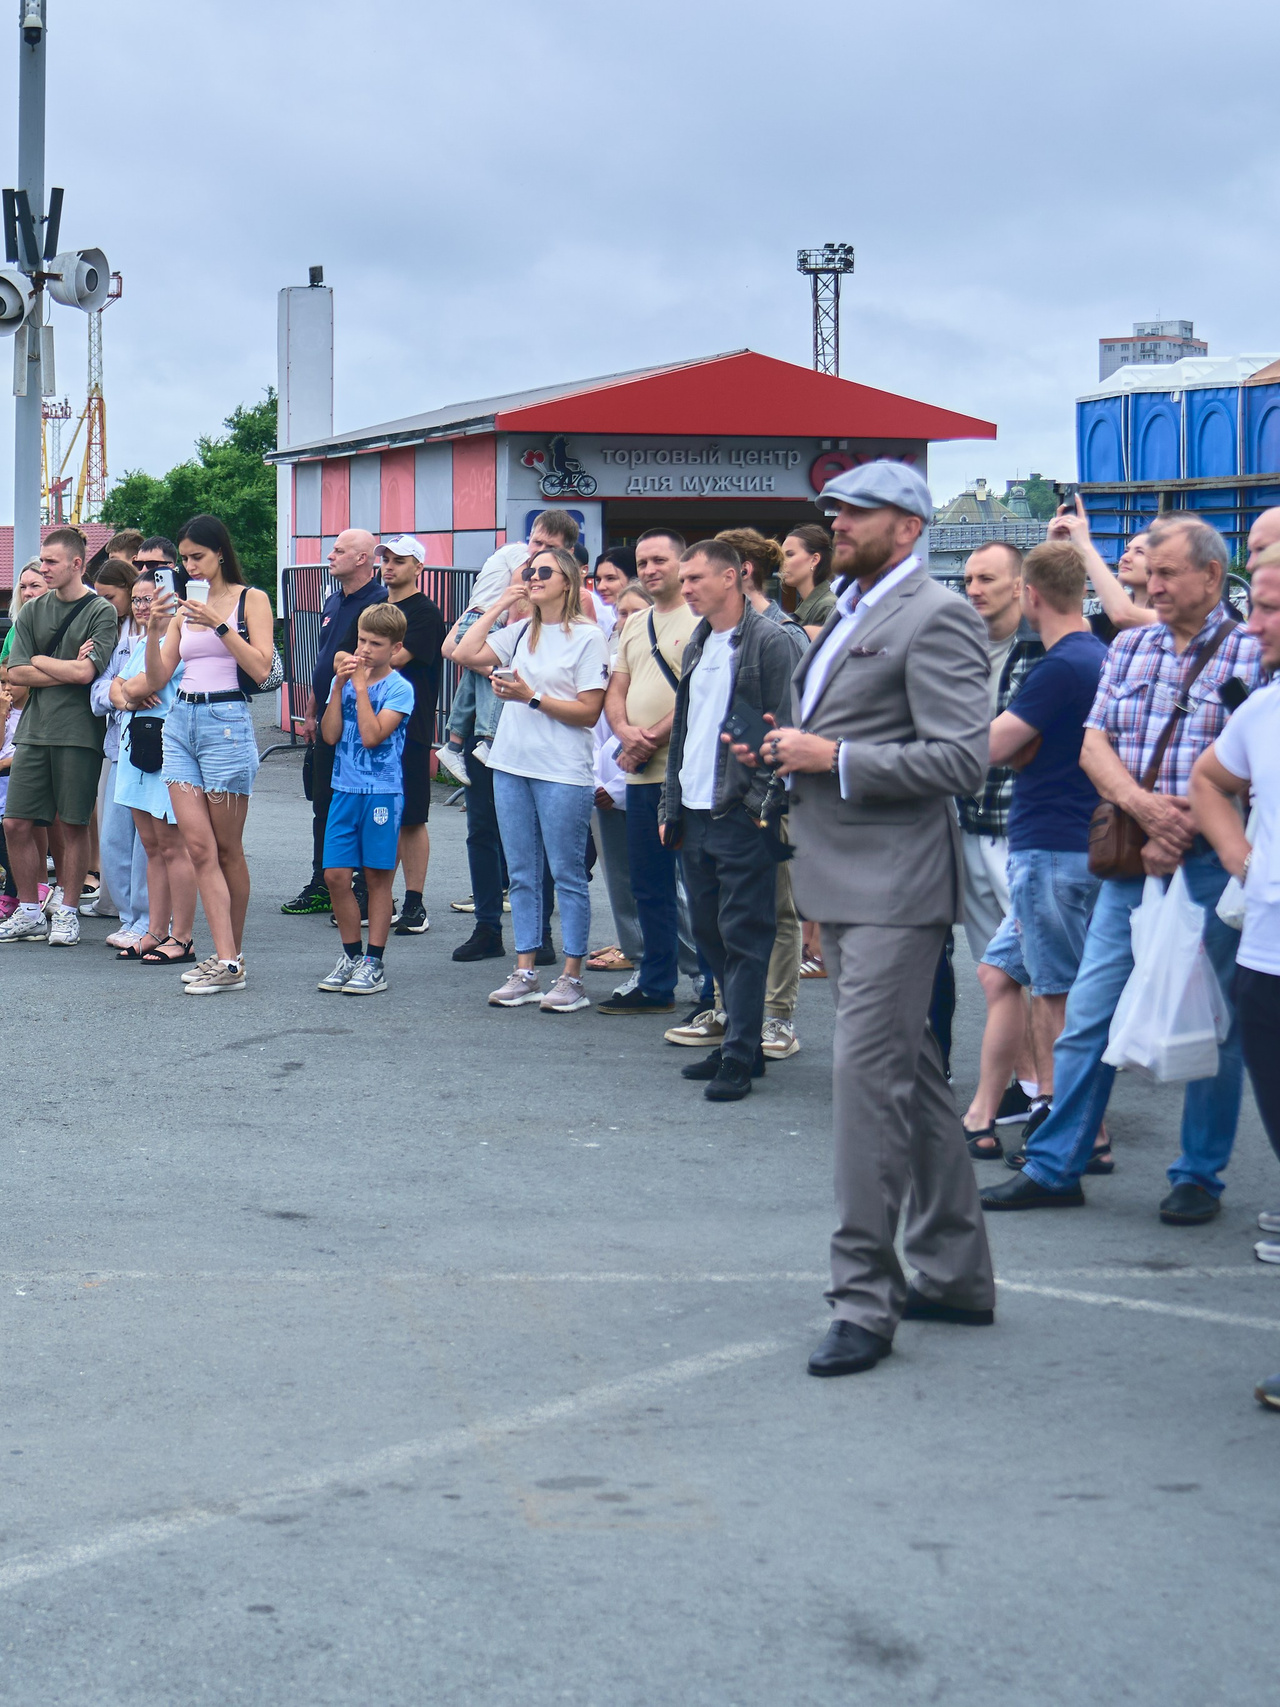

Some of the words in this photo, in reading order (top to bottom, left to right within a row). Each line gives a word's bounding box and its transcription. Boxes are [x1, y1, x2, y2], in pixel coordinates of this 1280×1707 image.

[602, 442, 724, 469] торговый
[729, 447, 802, 470] центр
[810, 440, 918, 495] ё
[626, 474, 674, 494] для
[681, 475, 776, 497] мужчин
